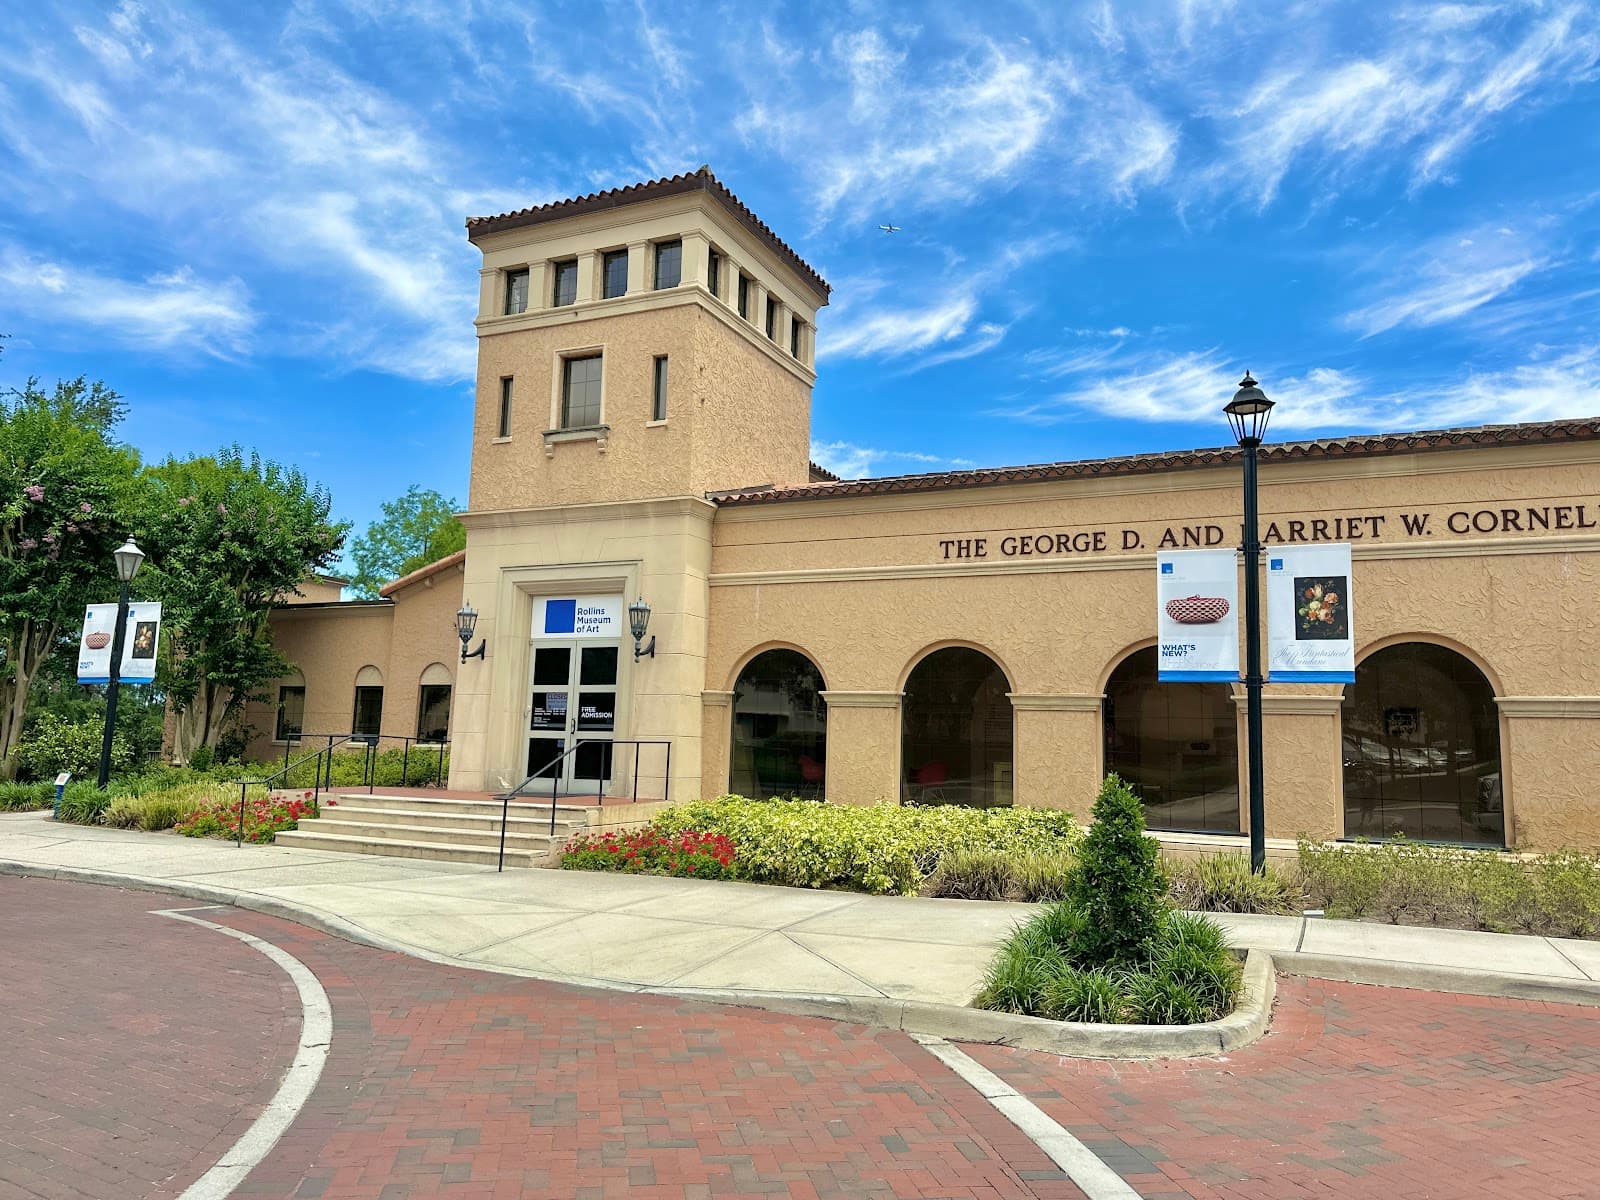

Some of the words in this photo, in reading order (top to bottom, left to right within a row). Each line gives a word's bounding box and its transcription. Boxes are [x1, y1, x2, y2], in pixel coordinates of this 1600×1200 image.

[939, 538, 988, 559] THE
[1000, 531, 1107, 556] GEORGE
[1121, 529, 1144, 550] D.
[1158, 525, 1224, 548] AND
[1239, 515, 1386, 545] ARRIET
[1399, 513, 1432, 536] W.
[1447, 504, 1600, 534] CORNEL
[577, 607, 605, 616] Rollins
[576, 616, 611, 624] Museum
[576, 625, 585, 633] of
[586, 624, 600, 633] Art
